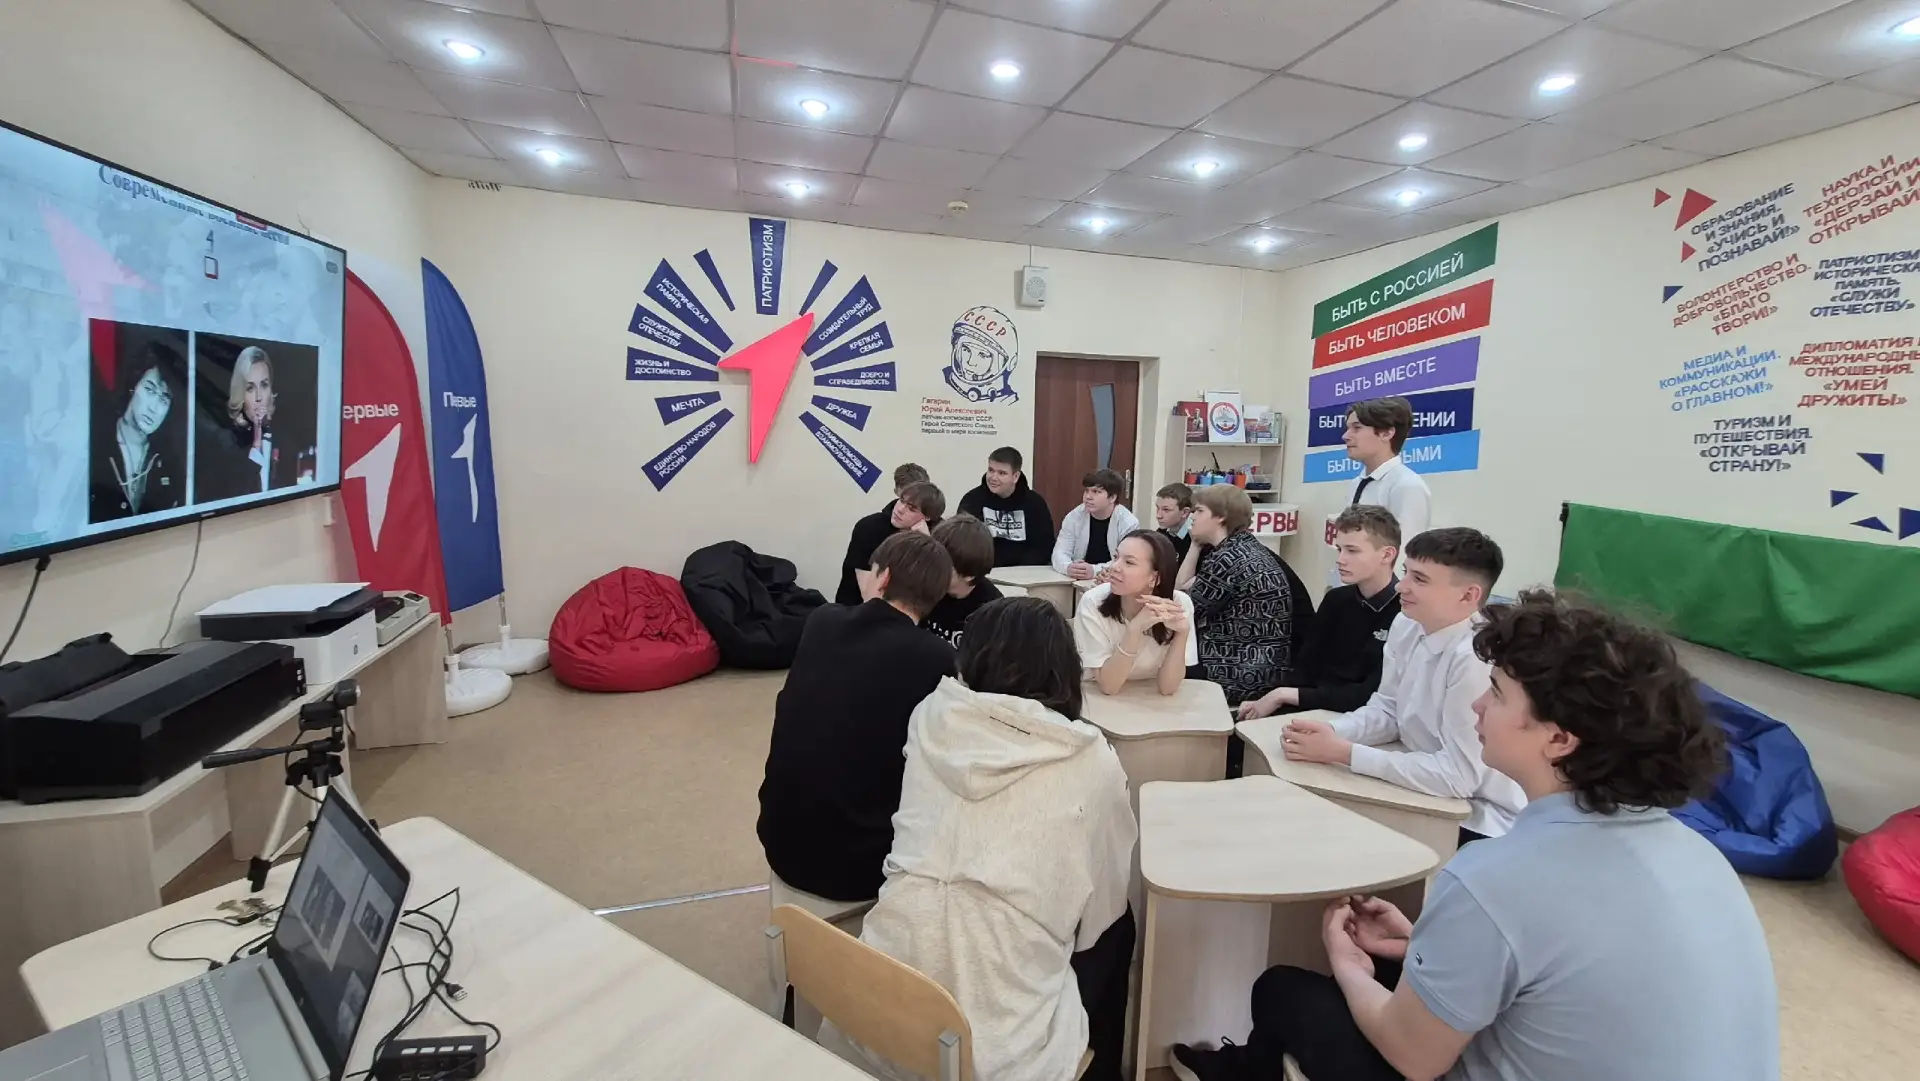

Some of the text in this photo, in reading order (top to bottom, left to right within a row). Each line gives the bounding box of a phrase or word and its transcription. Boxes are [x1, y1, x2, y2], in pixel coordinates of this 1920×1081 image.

[1821, 154, 1895, 197] НАУКА И
[1691, 182, 1795, 235] ОБРАЗОВАНИЕ
[1808, 187, 1920, 245] ОТКРЫВАЙ
[1814, 180, 1903, 227] «ДЕРЗАЙ
[1704, 203, 1782, 242] И ЗНАНИЯ.
[1707, 213, 1785, 254] «УЧИСЬ И
[1698, 224, 1800, 272] ПОЗНАВАЙ!»
[761, 224, 774, 308] ПАТРИОТИЗМ
[1331, 251, 1464, 323] БЫТЬ С РОССИЕЙ
[1673, 263, 1812, 328] ДОБРОВОЛЬЧЕСТВО.
[1677, 253, 1799, 313] ВОЛОНТЕРСТВО И
[1830, 287, 1900, 303] «СЛУЖИ
[1834, 277, 1901, 290] ПАМЯТЬ.
[656, 284, 682, 309] ПАМЯТЬ
[662, 278, 709, 324] ИСТОРИЧЕСКАЯ
[1713, 292, 1771, 322] «БЛАГО
[818, 296, 868, 341] СОЗИДАТЕЛЬНЫЙ
[856, 303, 874, 319] ТРУД
[638, 323, 681, 347] ОТЕЧЕСТВУ
[642, 316, 682, 340] СЛУЖЕНИЕ
[963, 311, 1007, 337] СССР
[1328, 303, 1466, 355] БЫТЬ ЧЕЛОВЕКОМ
[849, 331, 881, 351] КРЕПКАЯ
[859, 339, 884, 354] СЕМЬЯ
[1800, 336, 1914, 355] ДИПЛОМАТИЯ
[634, 359, 662, 367] ЖИЗНЬ
[1659, 349, 1782, 390] КОММУНИКАЦИИ.
[1683, 345, 1747, 371] МЕДИА И
[1804, 363, 1914, 377] ОТНОШЕНИЯ.
[634, 367, 692, 376] ДОСТОИНСТВО
[860, 371, 883, 379] ДОБРО
[1335, 356, 1437, 397] БЫТЬ ВМЕСТЕ
[1674, 366, 1767, 398] «РАССКАЖИ
[1822, 376, 1889, 391] «УМЕЙ
[670, 397, 706, 413] МЕЧТА
[922, 397, 951, 406] Гагарин
[1671, 381, 1774, 412] О ГЛАВНОМ!»
[343, 403, 400, 424] ервые
[825, 402, 857, 420] ДРУЖБА
[1318, 411, 1456, 429] БЫТ ЕНИИ
[1713, 414, 1791, 431] ТУРИЗМ И
[653, 421, 717, 472] ЕДИНСТВО НАРОДОВ
[819, 425, 863, 469] ВЗАИМОПОМОЩЬ
[1694, 427, 1813, 445] ПУТЕШЕСТВИЯ.
[815, 431, 864, 478] ВЗАИМОУВАЖЕНИЕ
[1327, 444, 1442, 474] БЫТЬ ЫМИ
[1699, 440, 1806, 458] «ОТКРЫВАЙ
[659, 454, 688, 478] РОССИИ
[1709, 458, 1791, 472] СТРАНУ!»
[1248, 510, 1299, 533] РВЫ
